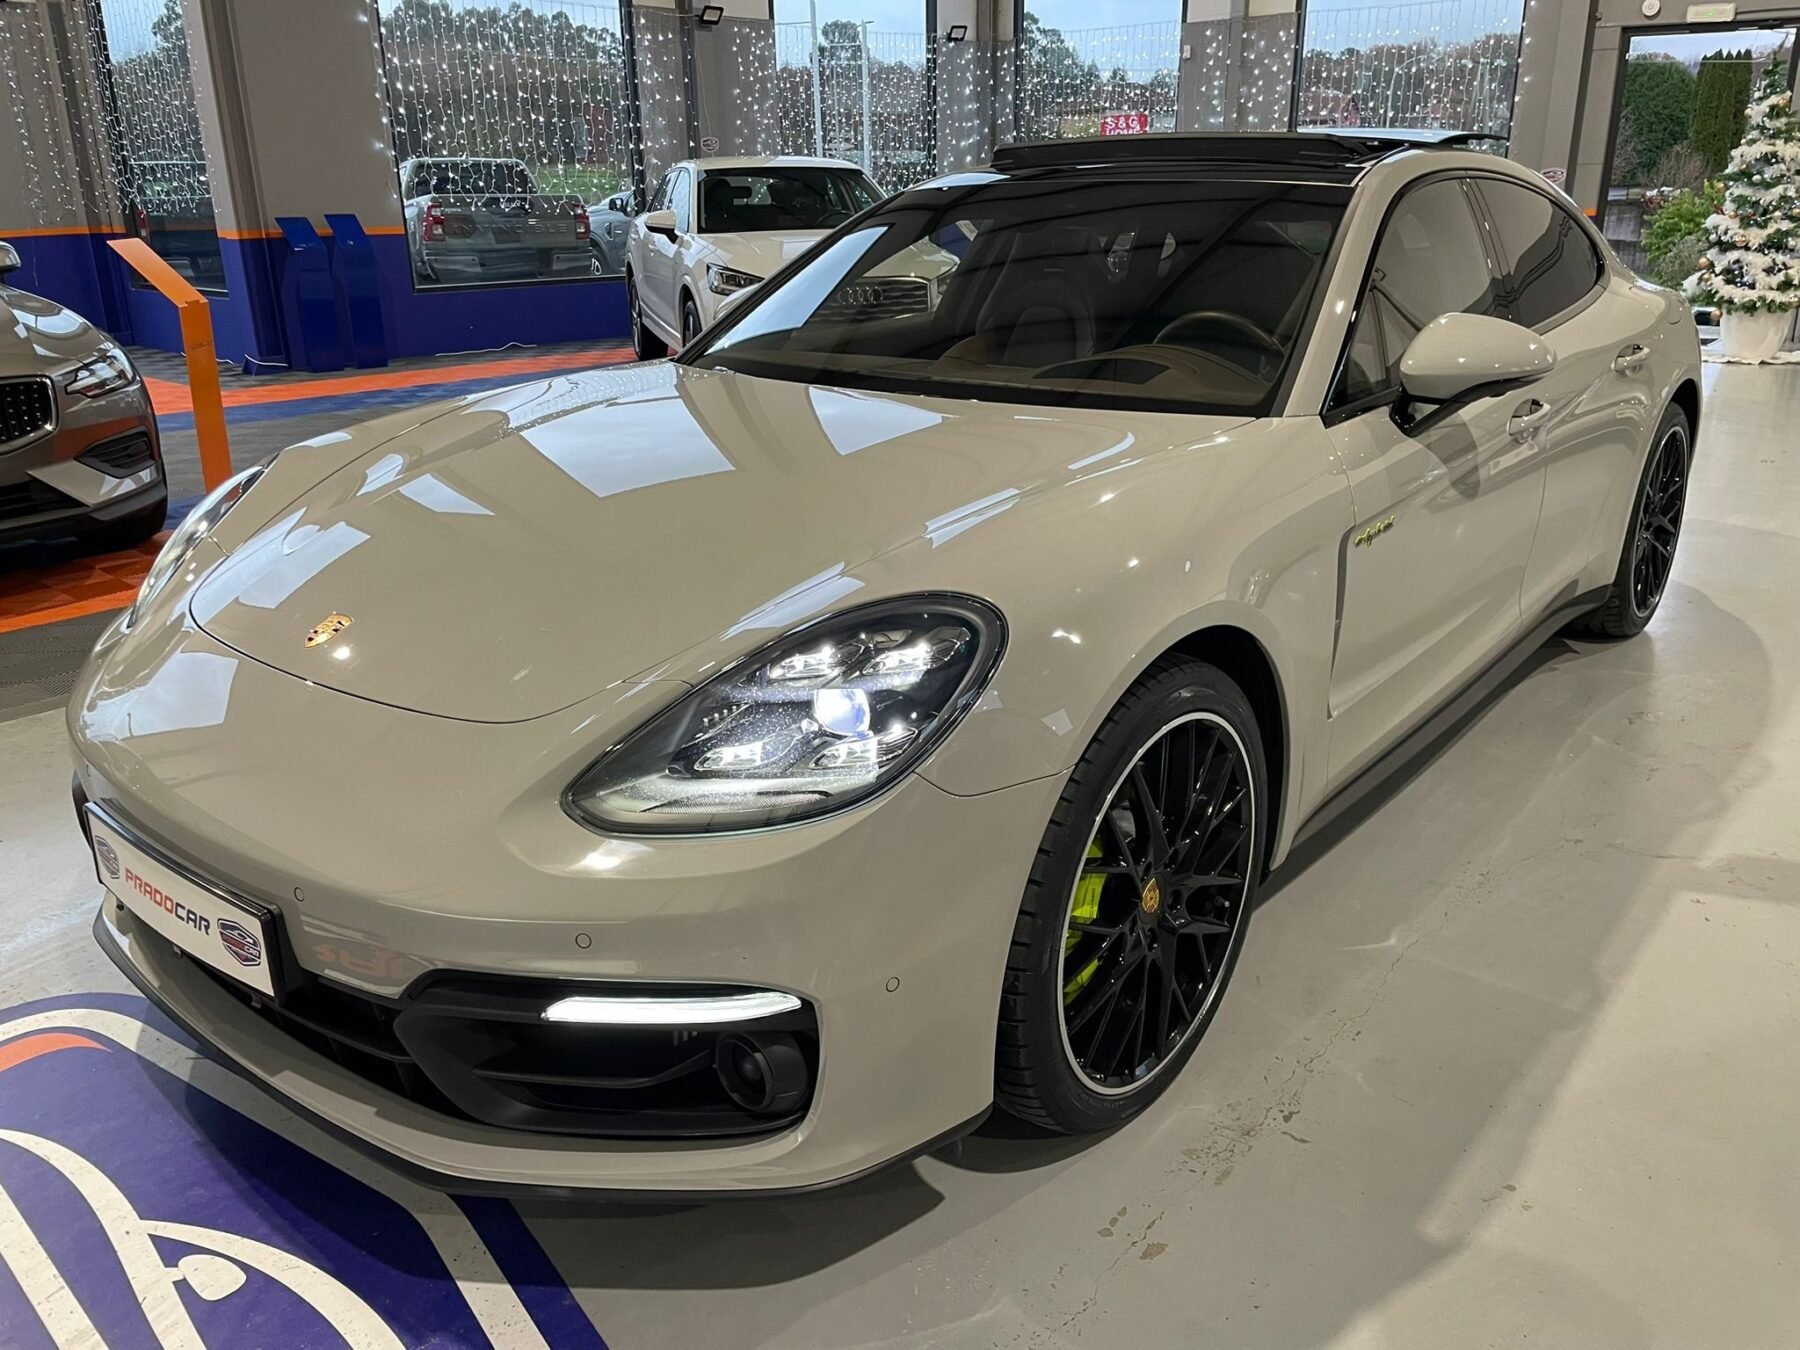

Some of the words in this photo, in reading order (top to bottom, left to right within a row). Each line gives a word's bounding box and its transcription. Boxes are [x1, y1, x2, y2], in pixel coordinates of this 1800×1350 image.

[1104, 117, 1116, 128] S
[1118, 116, 1126, 128] &
[1129, 116, 1140, 128] G
[455, 223, 568, 236] INVINCIBLE
[124, 867, 211, 936] PRADOCAR
